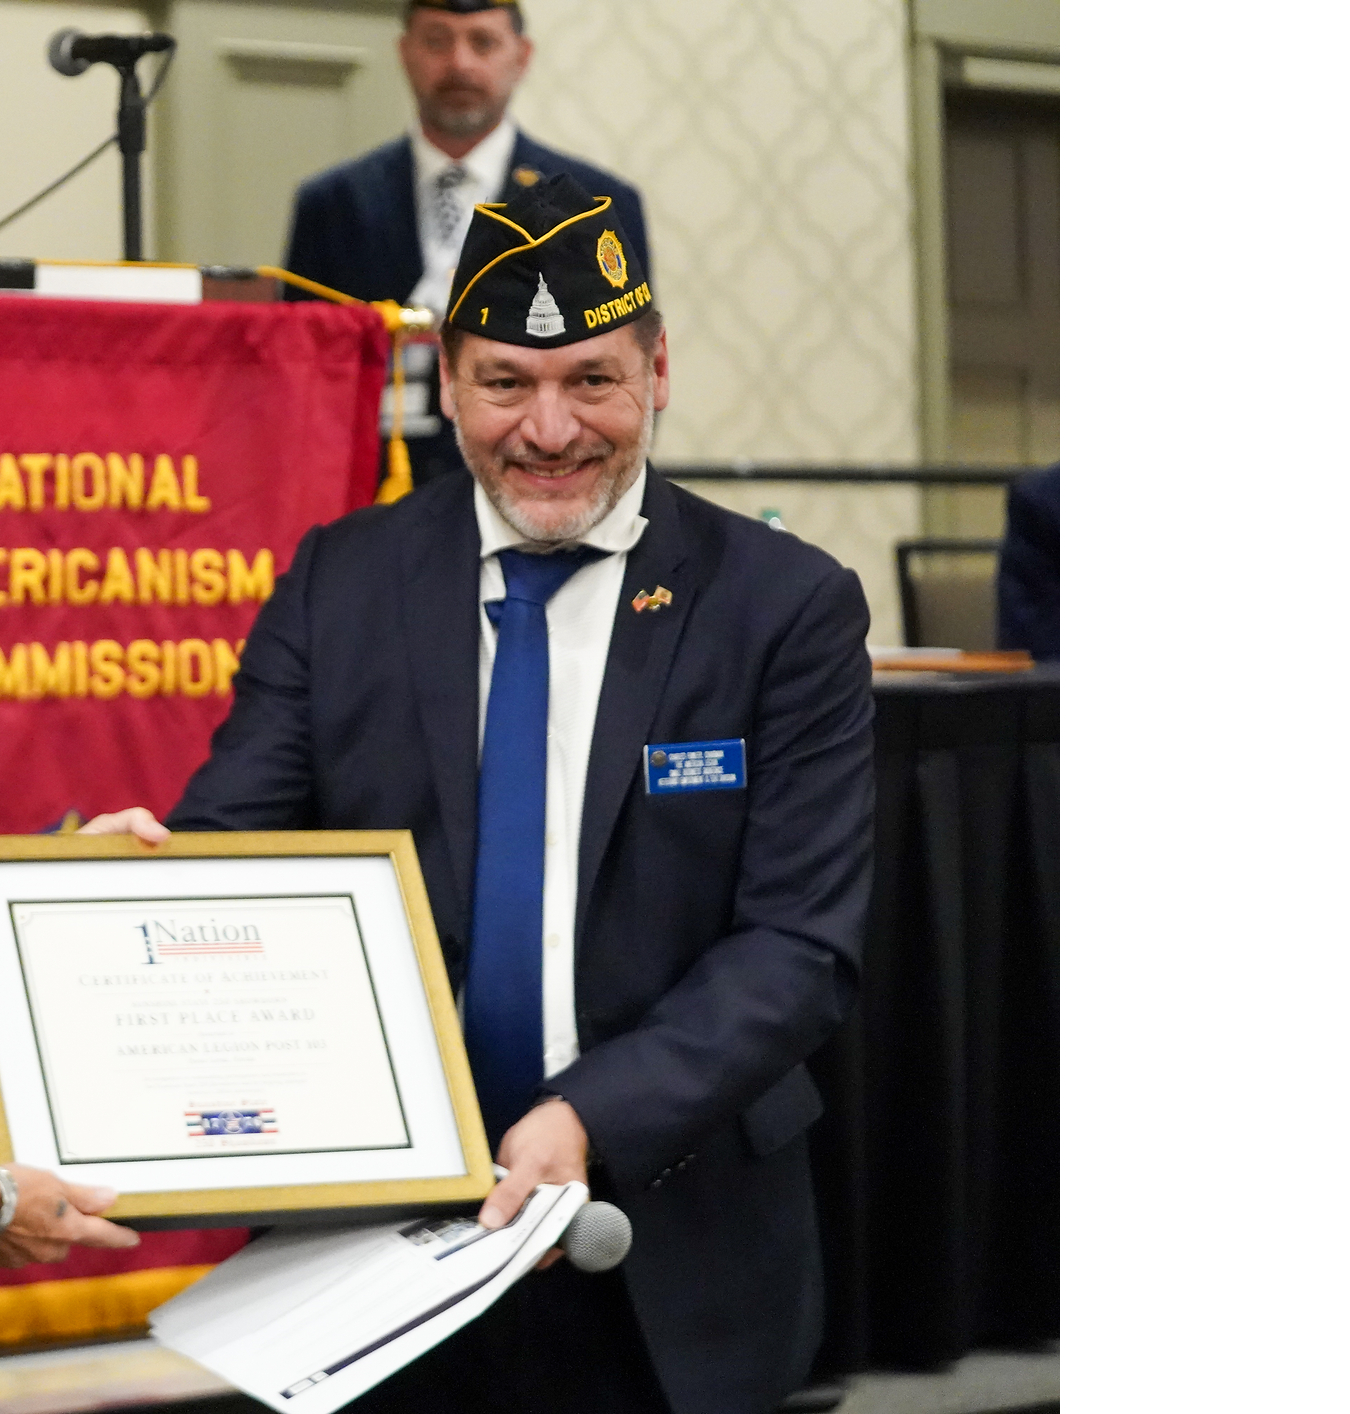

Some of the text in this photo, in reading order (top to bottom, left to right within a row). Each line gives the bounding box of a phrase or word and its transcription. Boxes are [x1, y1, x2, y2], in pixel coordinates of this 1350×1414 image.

[480, 307, 489, 325] 1
[583, 290, 637, 329] DISTRICT
[153, 918, 262, 943] Nation
[79, 969, 330, 987] CERTIFICATE OF ACHIEVEMENT
[115, 1007, 316, 1026] FIRST PLACE AWARD
[117, 1042, 199, 1056] AMERICAN
[203, 1040, 260, 1053] LEGION
[265, 1039, 301, 1052] POST
